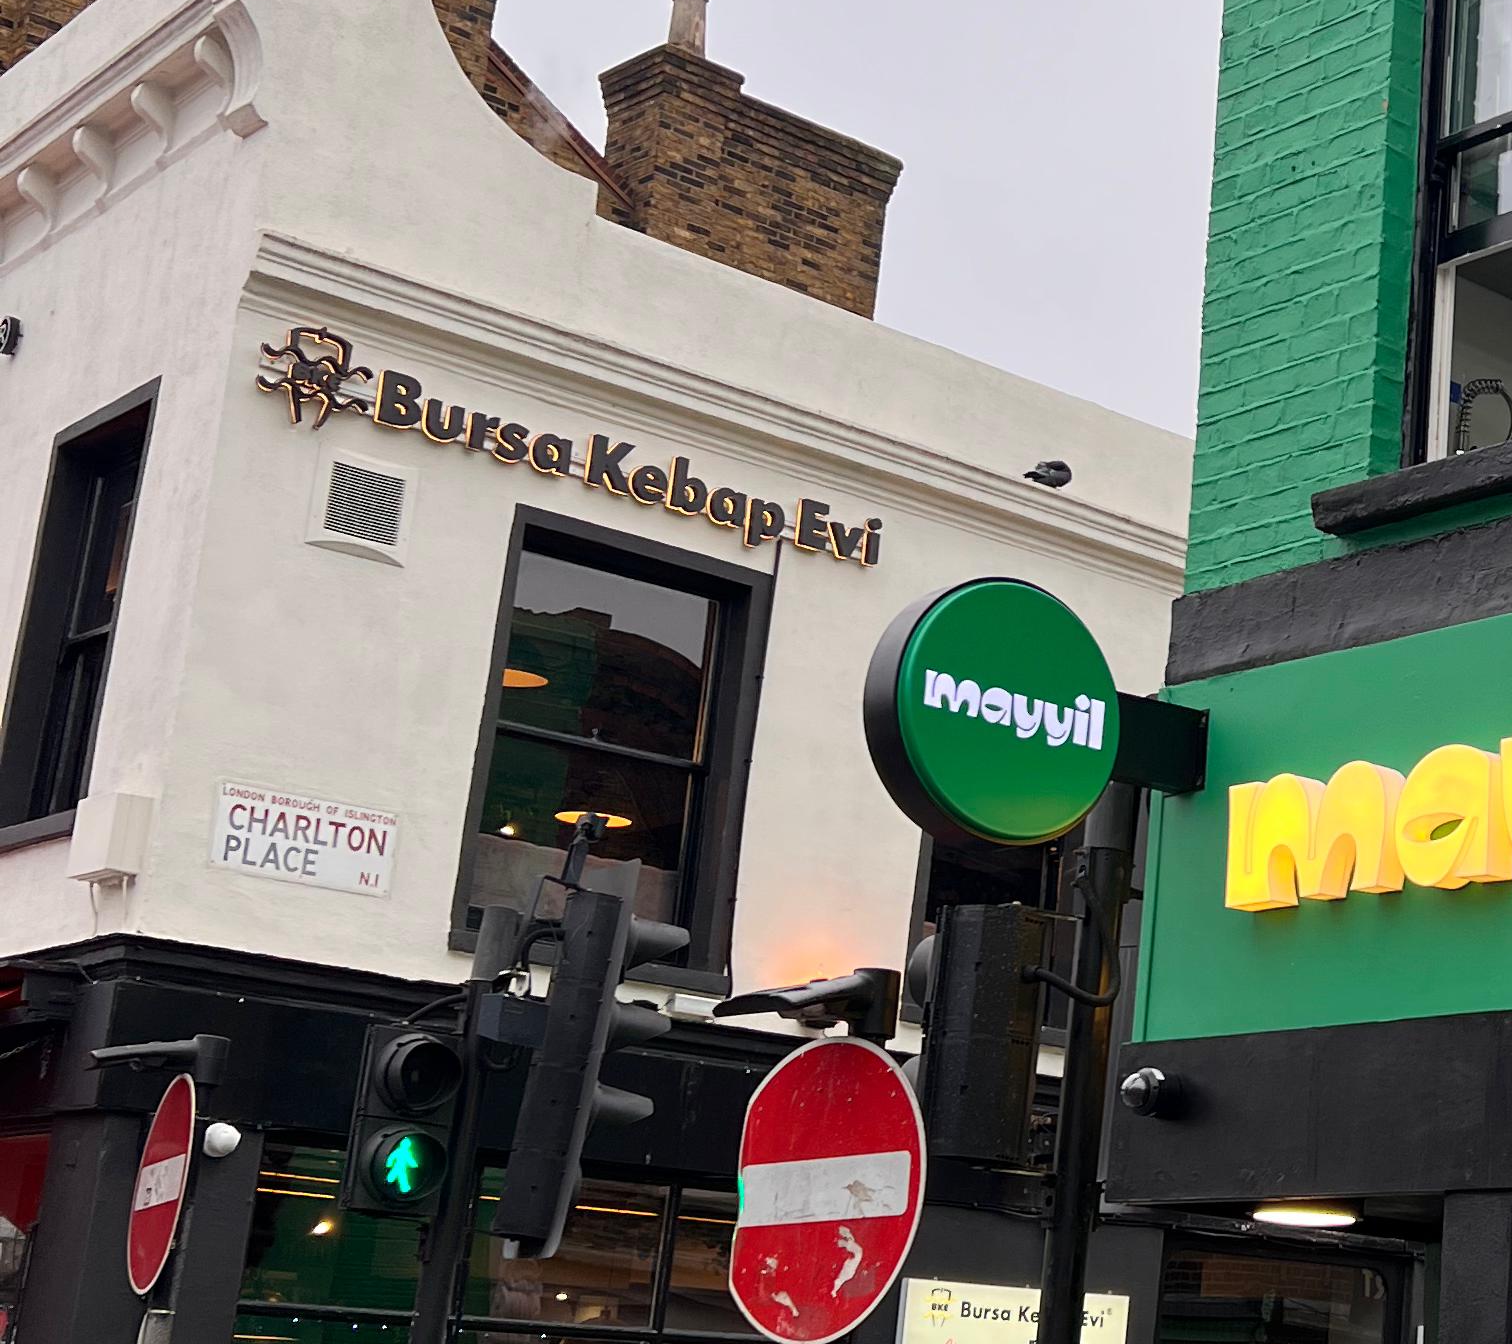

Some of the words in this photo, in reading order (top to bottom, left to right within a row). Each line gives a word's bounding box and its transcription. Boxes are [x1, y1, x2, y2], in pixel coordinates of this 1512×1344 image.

[374, 369, 572, 478] Bursa
[583, 434, 785, 547] Kebap
[794, 497, 883, 567] Evi
[923, 669, 1106, 751] mayyil
[223, 786, 265, 802] LONDON
[271, 795, 320, 812] BOROUGH
[326, 805, 339, 815] OF
[345, 809, 397, 826] ISLINGTON
[229, 804, 387, 856] CHARLTON
[223, 835, 319, 876] PLACE
[961, 1301, 1011, 1322] Bursa
